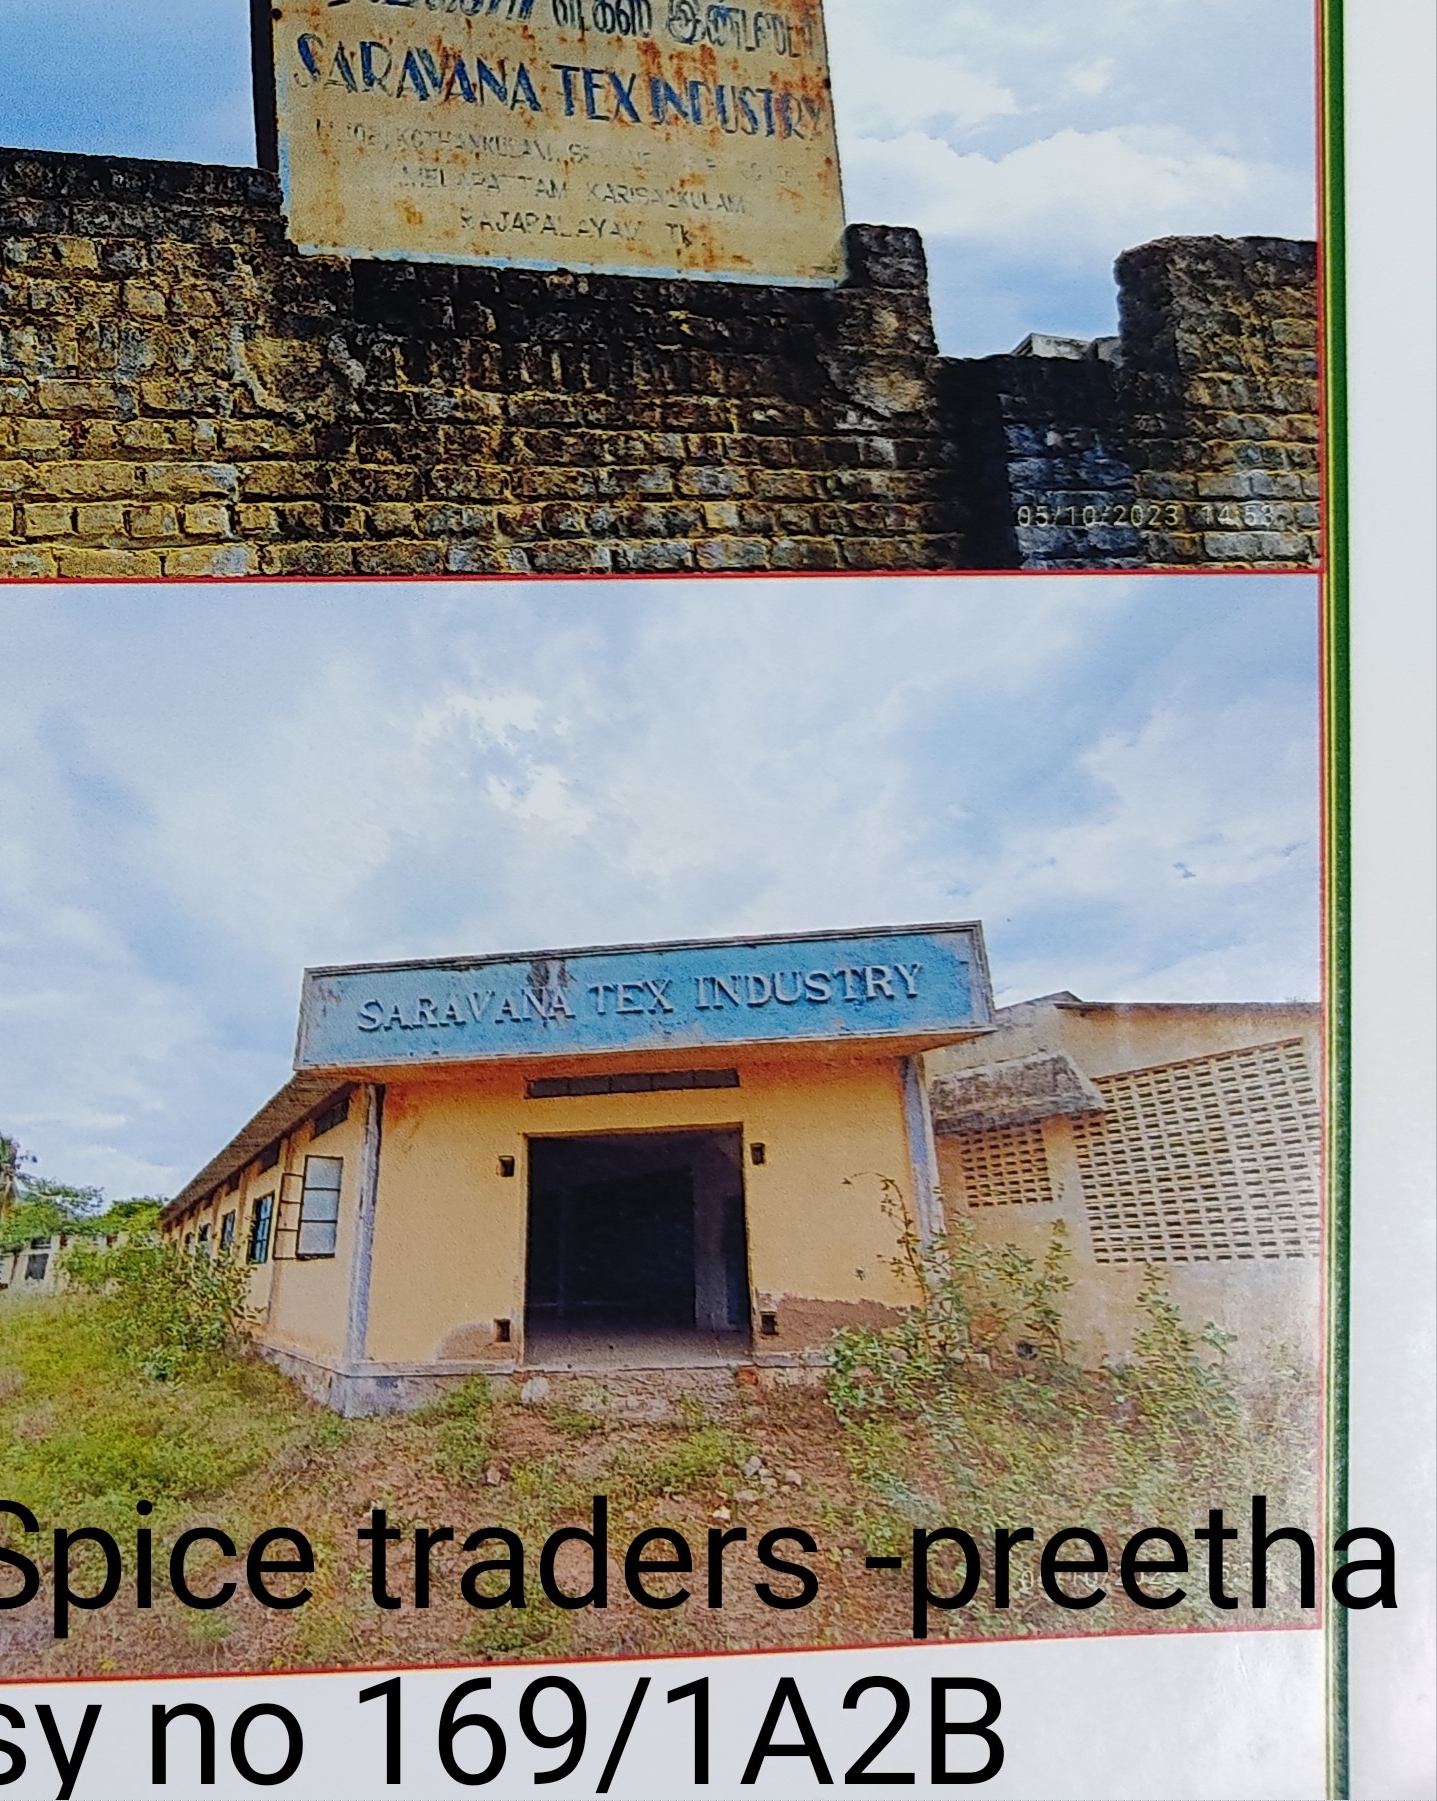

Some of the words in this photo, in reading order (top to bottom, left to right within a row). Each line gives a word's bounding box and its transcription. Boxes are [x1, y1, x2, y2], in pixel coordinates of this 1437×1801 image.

[292, 32, 543, 112] SARAVANA
[550, 62, 642, 124] TEX
[646, 75, 828, 141] INDUSTRY
[357, 989, 576, 1033] SARAVANA
[587, 979, 674, 1015] TEX
[696, 962, 924, 1011] INDUSTRY
